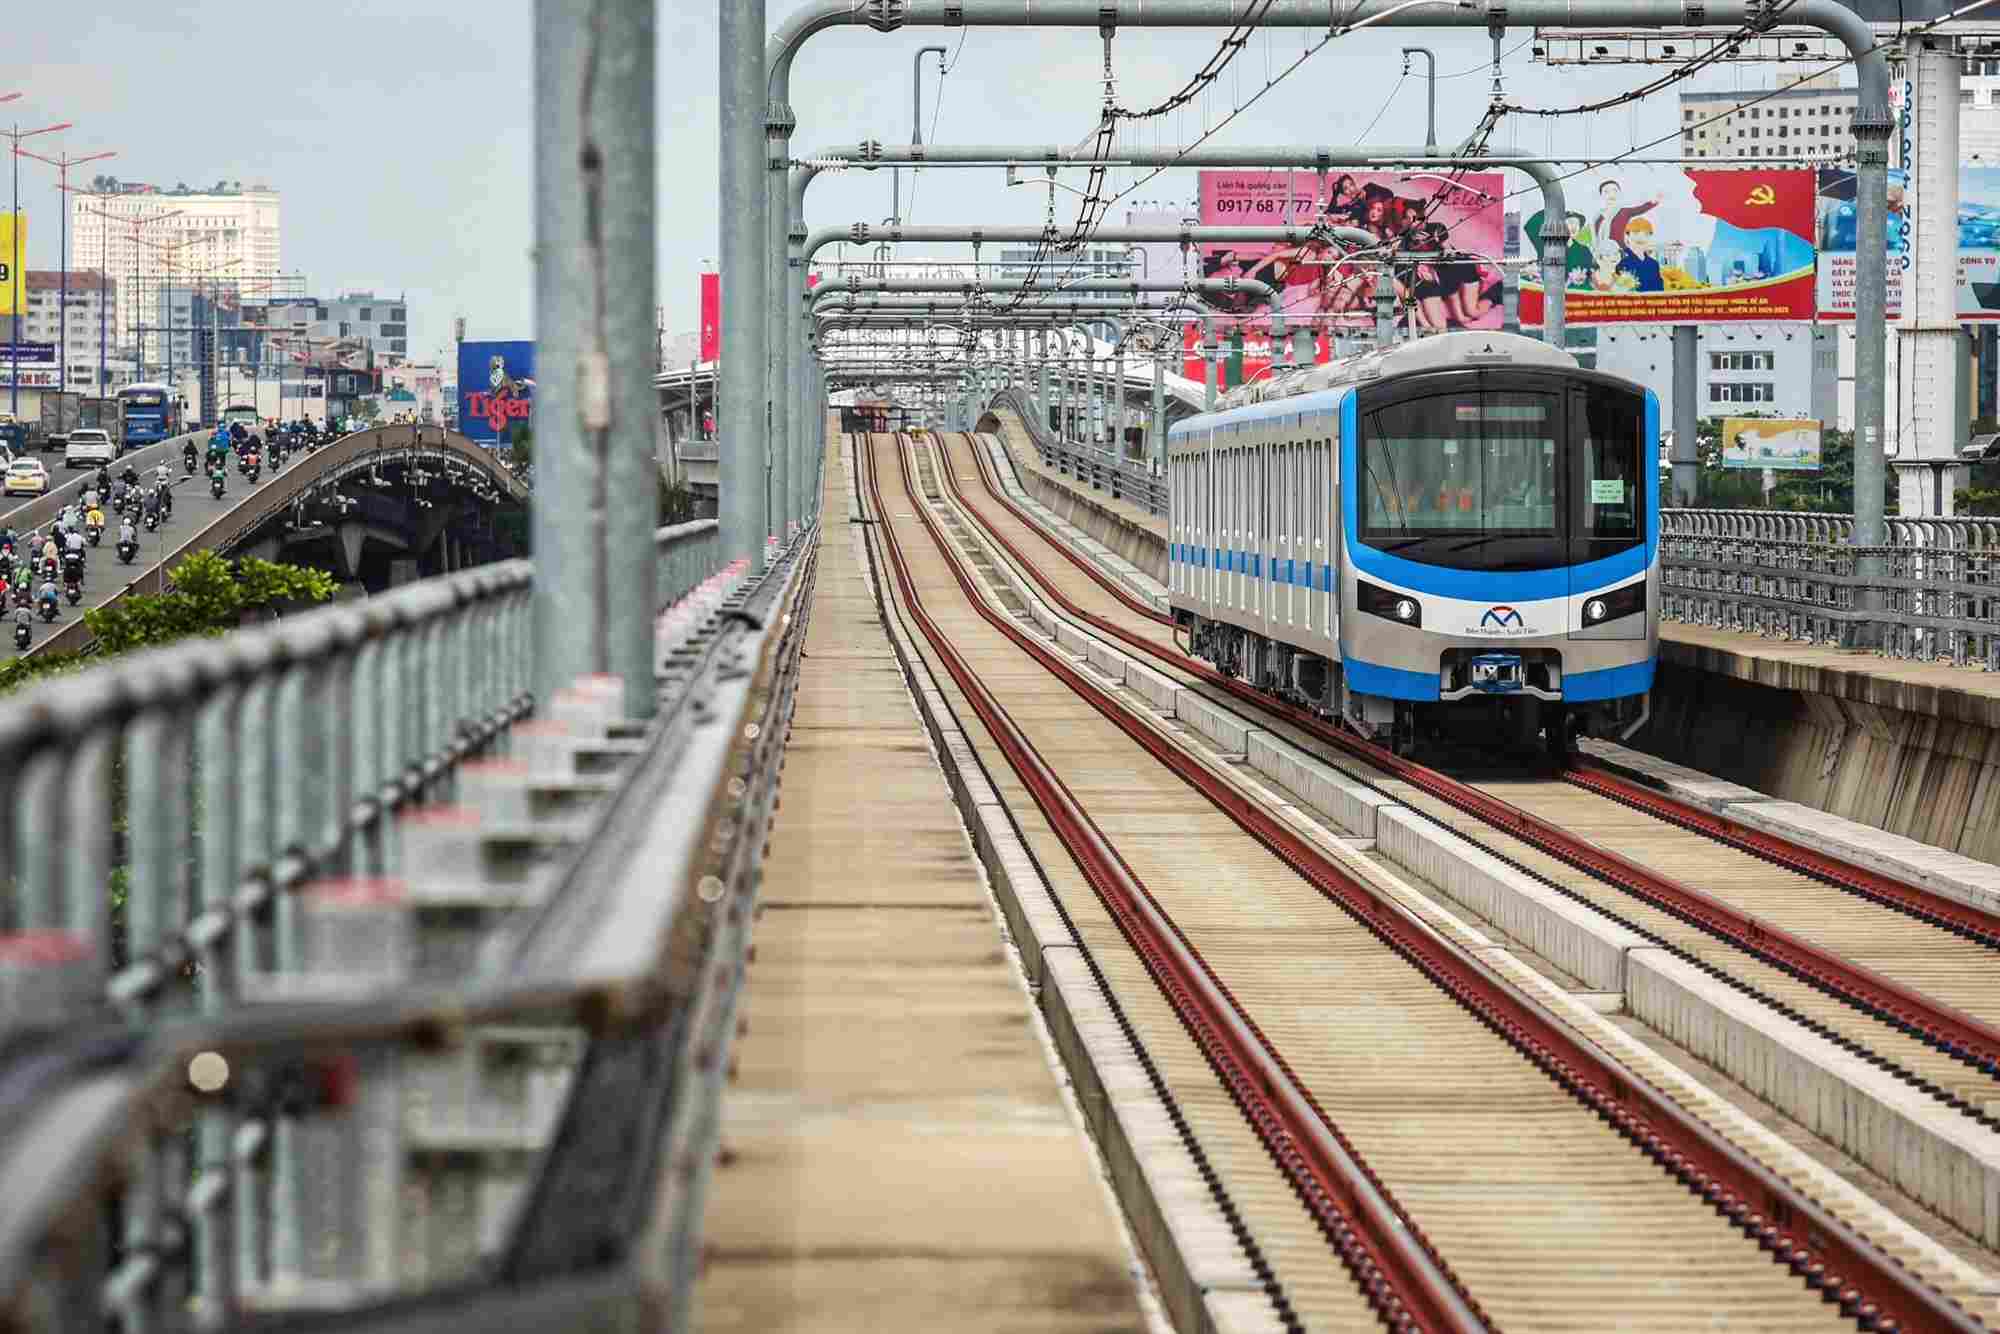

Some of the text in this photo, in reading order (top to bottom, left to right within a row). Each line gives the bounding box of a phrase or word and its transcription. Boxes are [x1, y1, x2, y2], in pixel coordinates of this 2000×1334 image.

[1216, 199, 1253, 213] 0917
[1256, 199, 1274, 213] 68
[464, 390, 530, 432] Tiger
